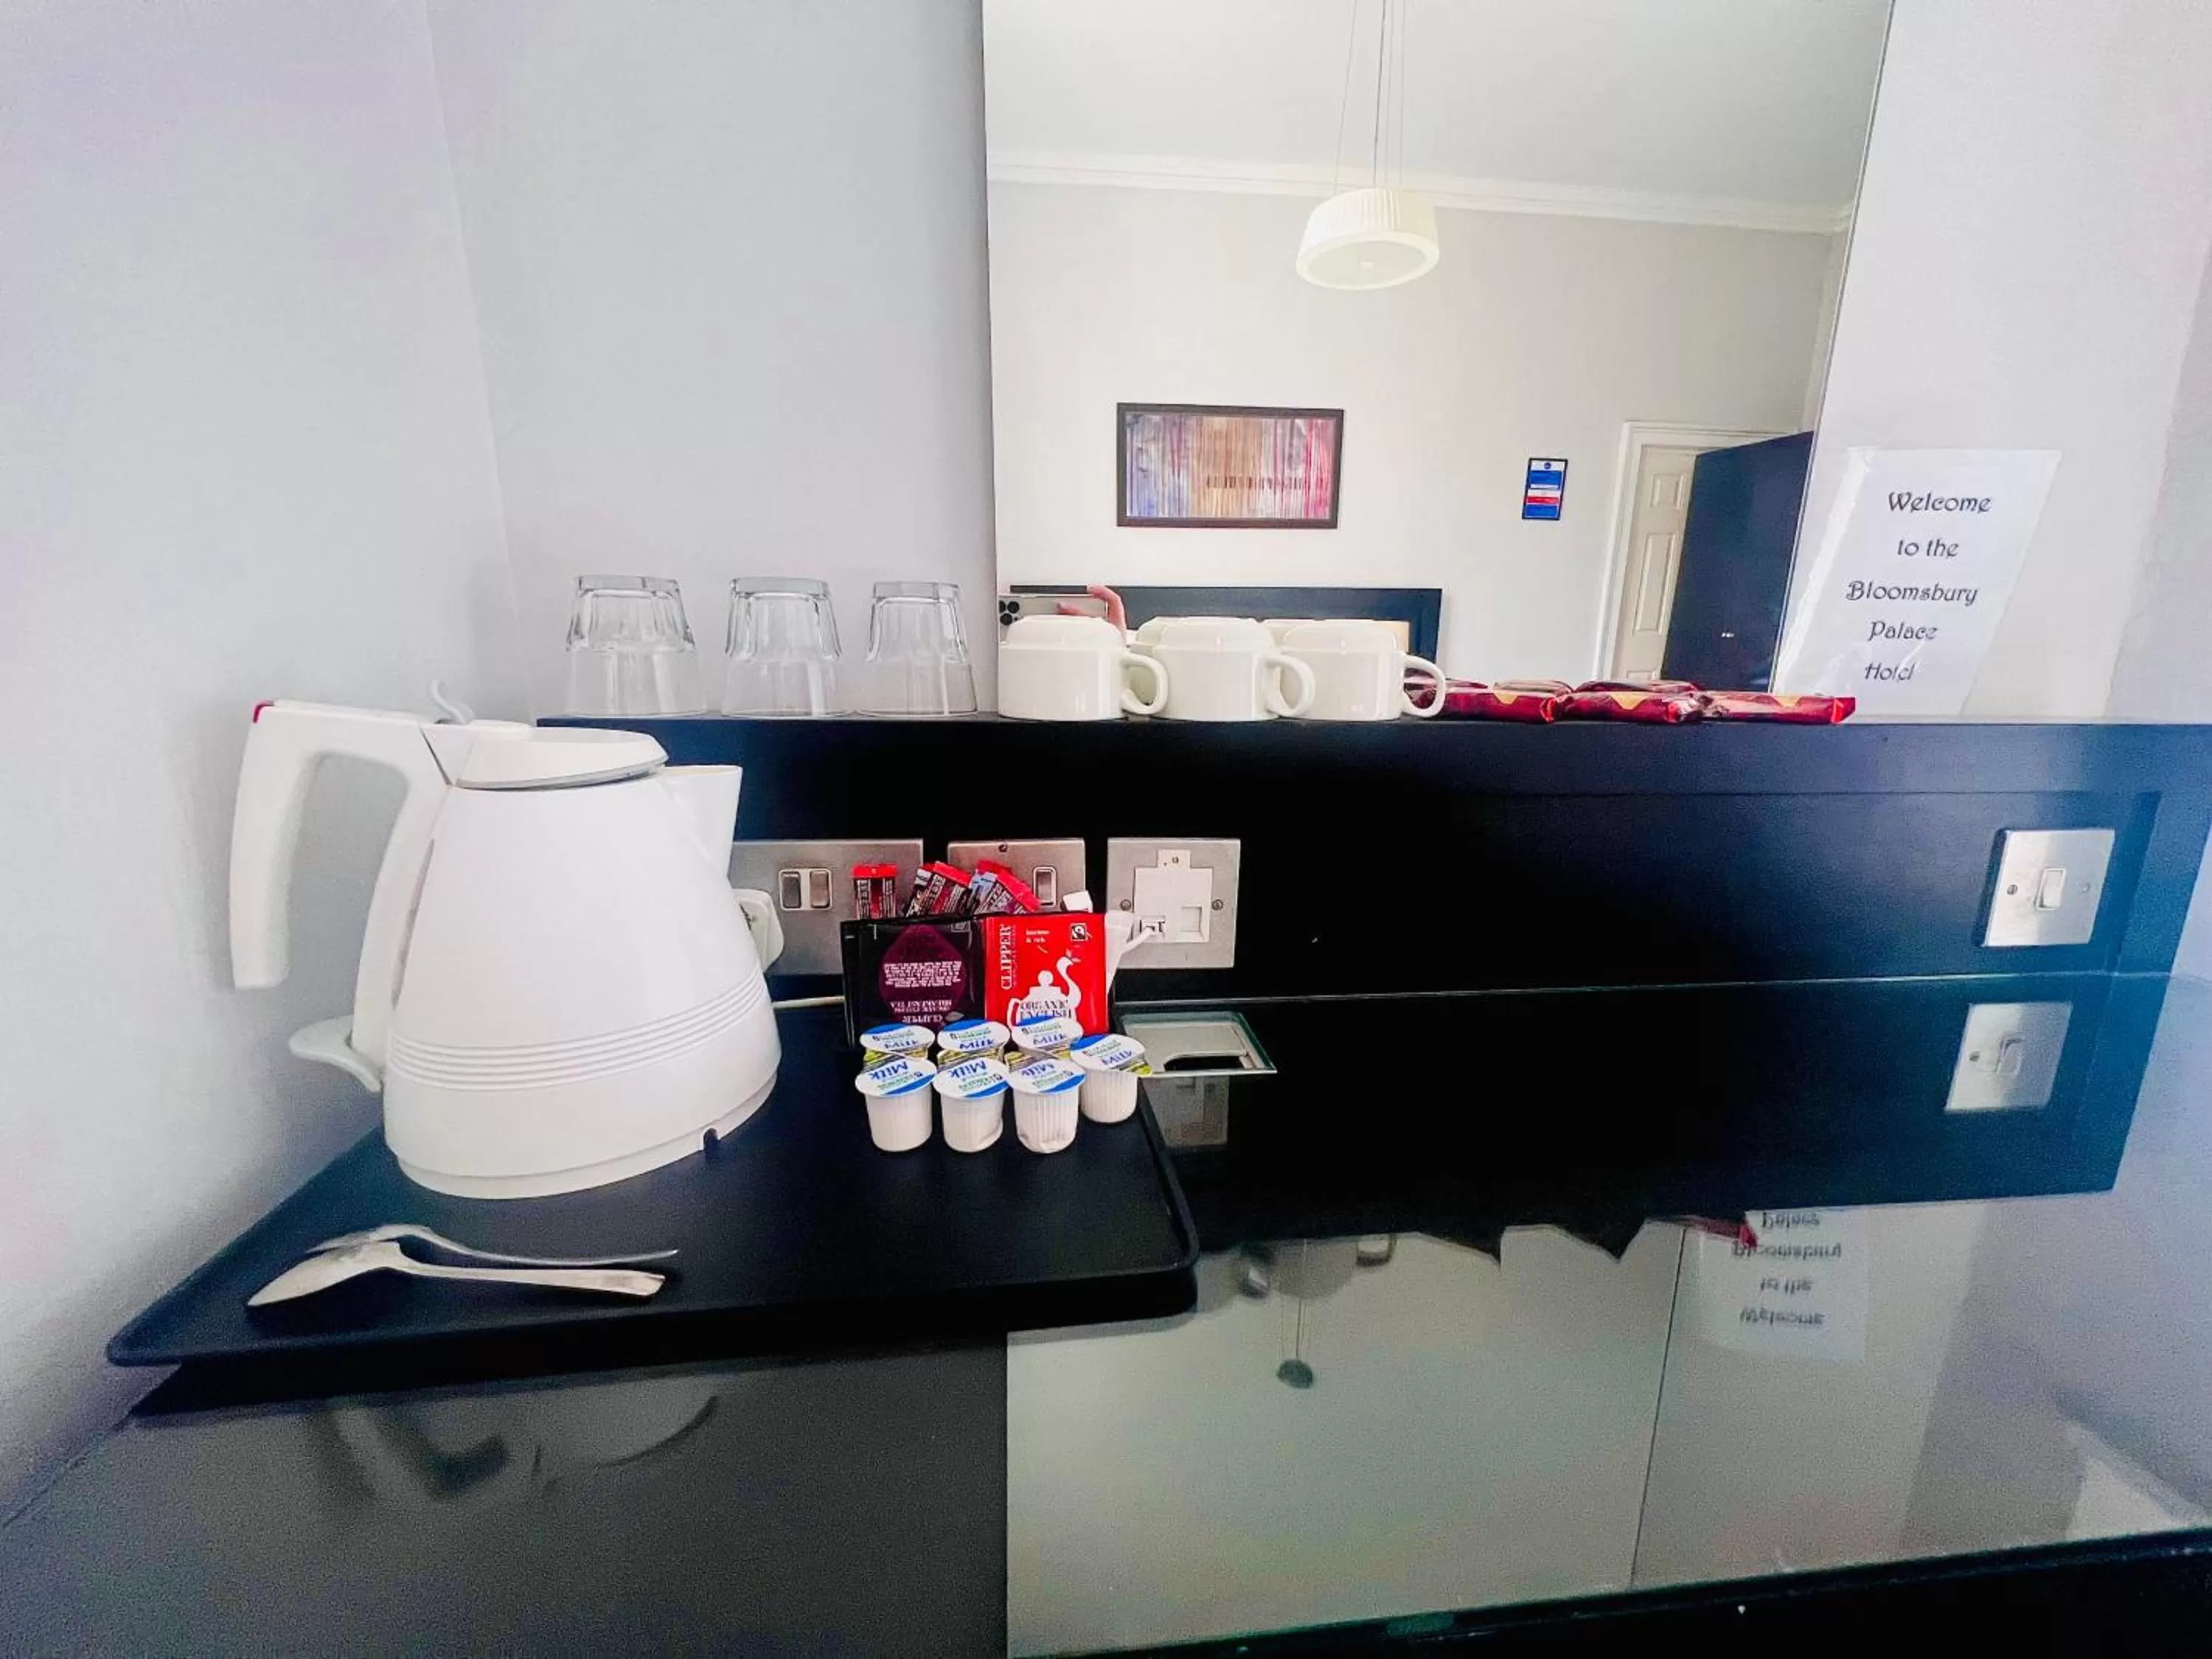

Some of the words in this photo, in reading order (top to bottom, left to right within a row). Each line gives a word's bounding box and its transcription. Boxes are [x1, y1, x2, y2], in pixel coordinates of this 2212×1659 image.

[1888, 491, 1992, 515] Welcome
[1897, 539, 1919, 557] to
[1926, 539, 1959, 559] the
[1846, 580, 1978, 607] Bloomsbury
[1867, 620, 1938, 641] Palace
[999, 924, 1012, 990] CLIPPER
[959, 1038, 994, 1050] Milk
[869, 1061, 908, 1080] Milk
[950, 1060, 987, 1079] Milk
